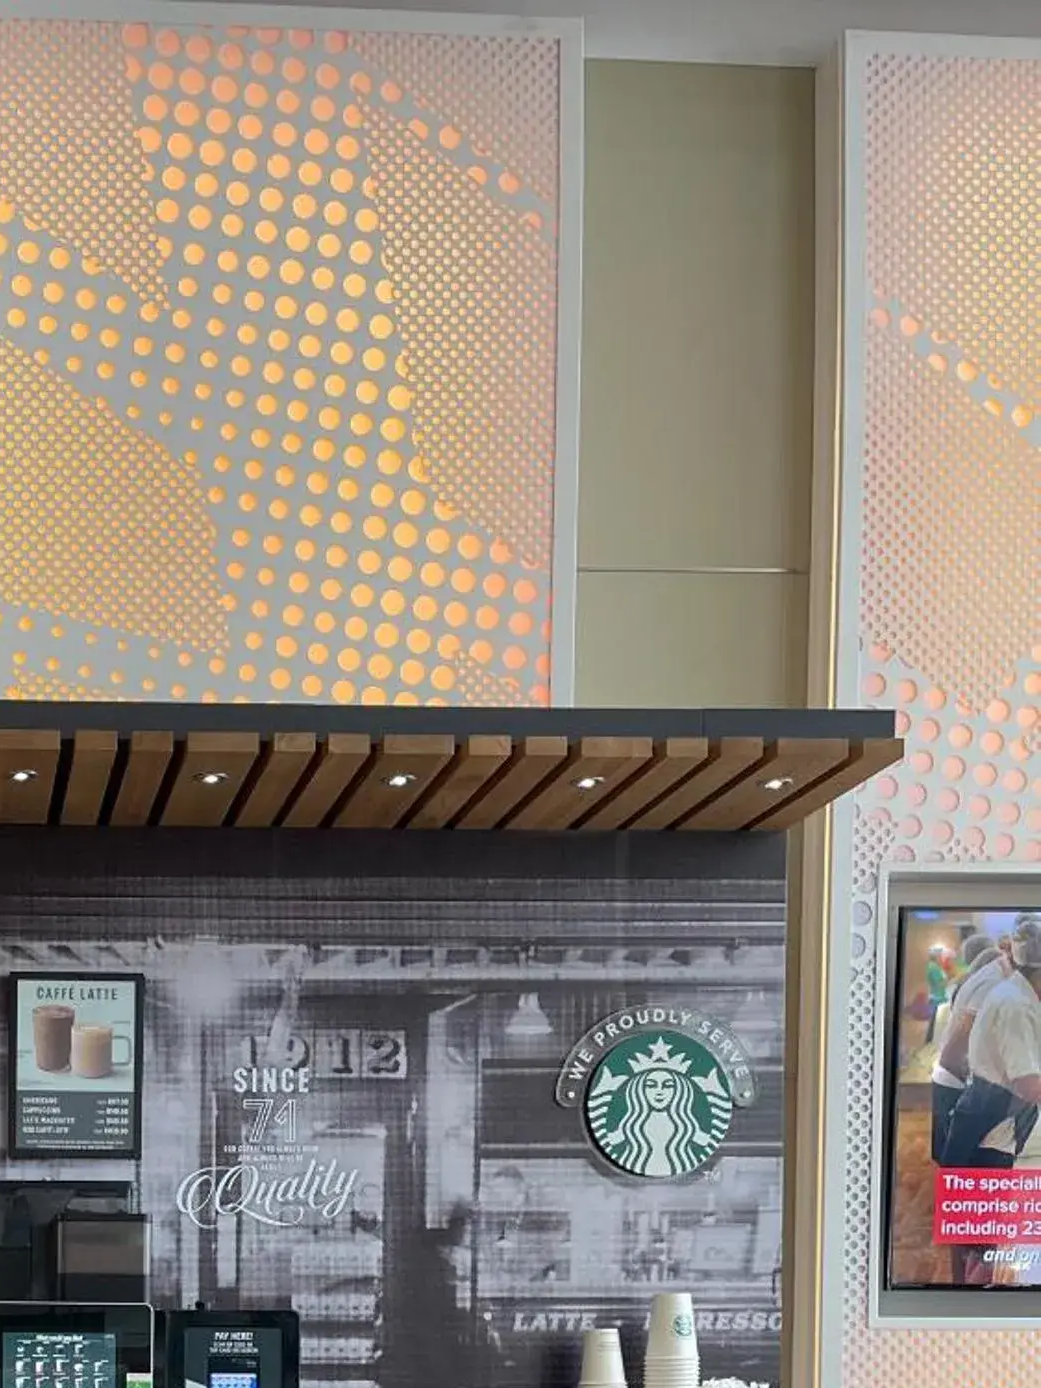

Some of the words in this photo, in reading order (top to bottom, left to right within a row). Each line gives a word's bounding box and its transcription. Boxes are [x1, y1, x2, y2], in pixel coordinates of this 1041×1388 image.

[80, 987, 119, 1000] LATTE
[569, 1050, 594, 1080] WE
[593, 1008, 692, 1047] PROUDLY
[697, 1020, 750, 1079] SERVE
[233, 1067, 309, 1093] SINCE
[243, 1098, 297, 1143] 71
[943, 1174, 975, 1190] The
[176, 1158, 358, 1228] Quality
[942, 1198, 1019, 1216] comprise
[941, 1219, 1018, 1239] including
[983, 1247, 1016, 1262] and
[513, 1313, 597, 1332] LATTE
